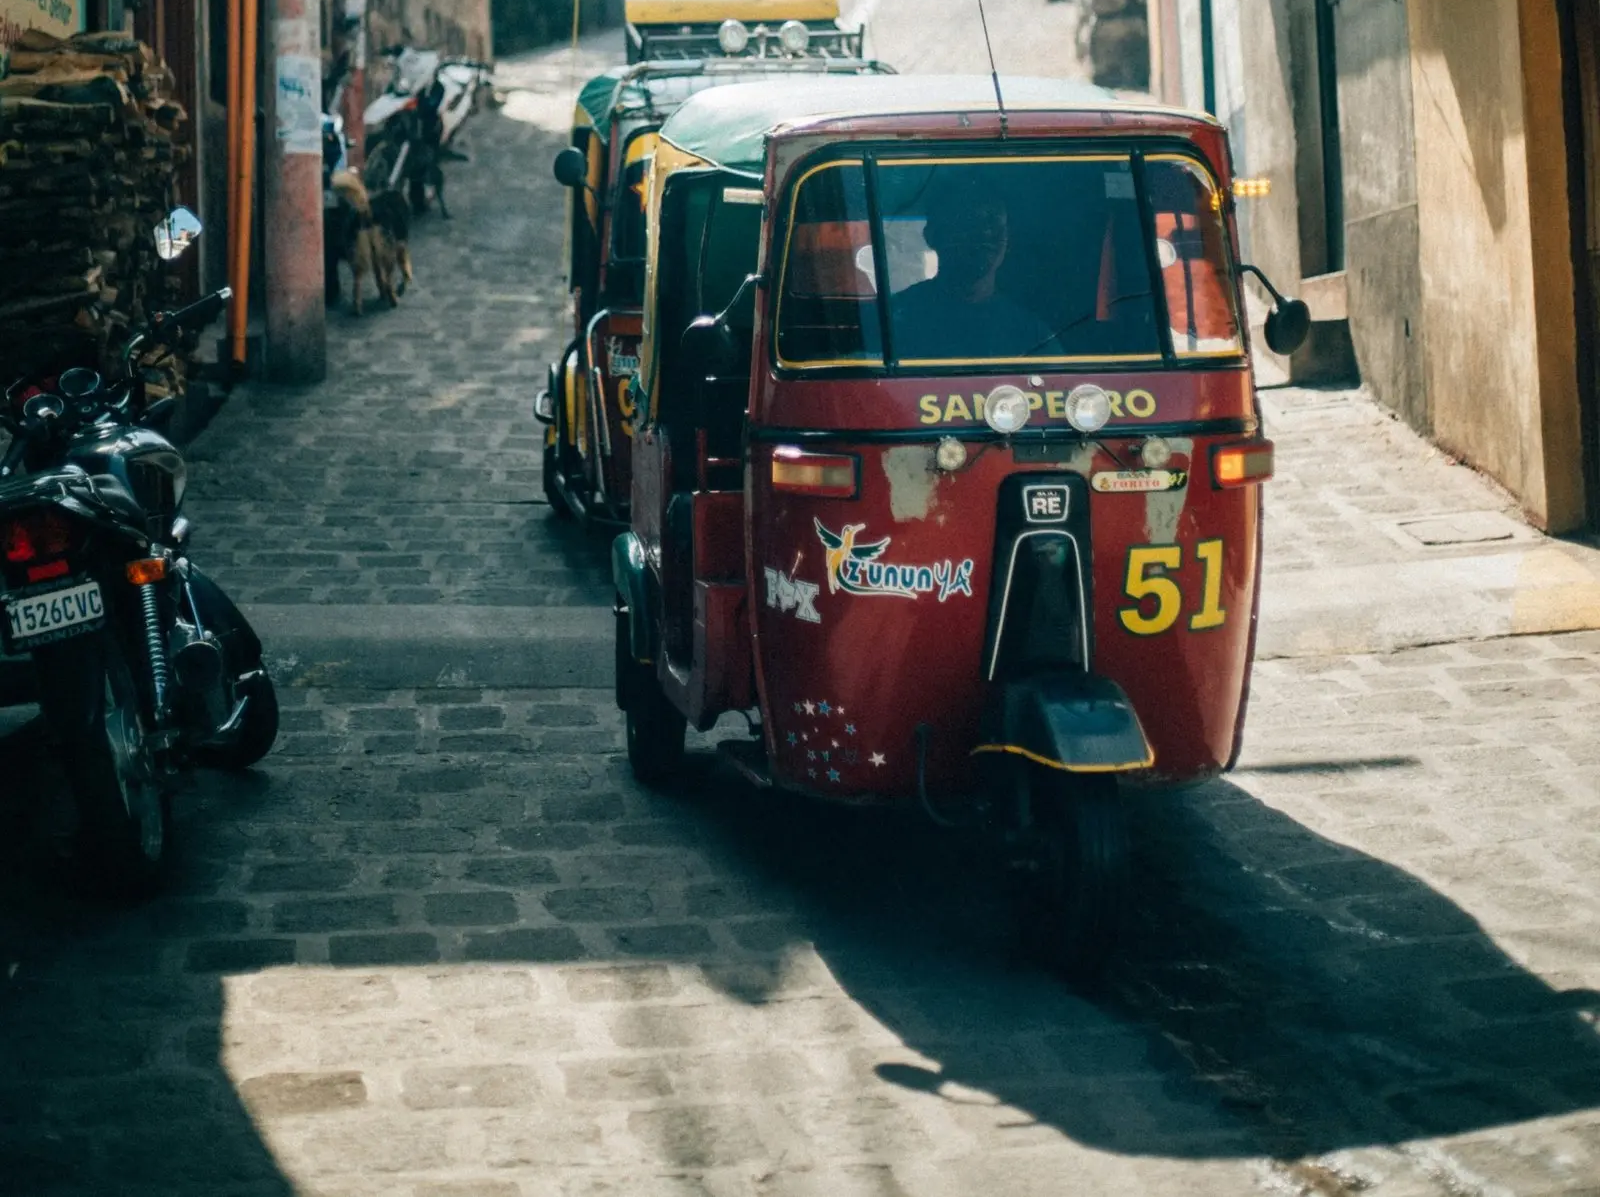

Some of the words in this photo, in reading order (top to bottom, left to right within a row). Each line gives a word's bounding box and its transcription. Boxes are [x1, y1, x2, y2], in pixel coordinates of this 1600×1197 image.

[1027, 389, 1157, 419] PERO
[1032, 497, 1062, 515] RE
[1119, 539, 1226, 635] 51
